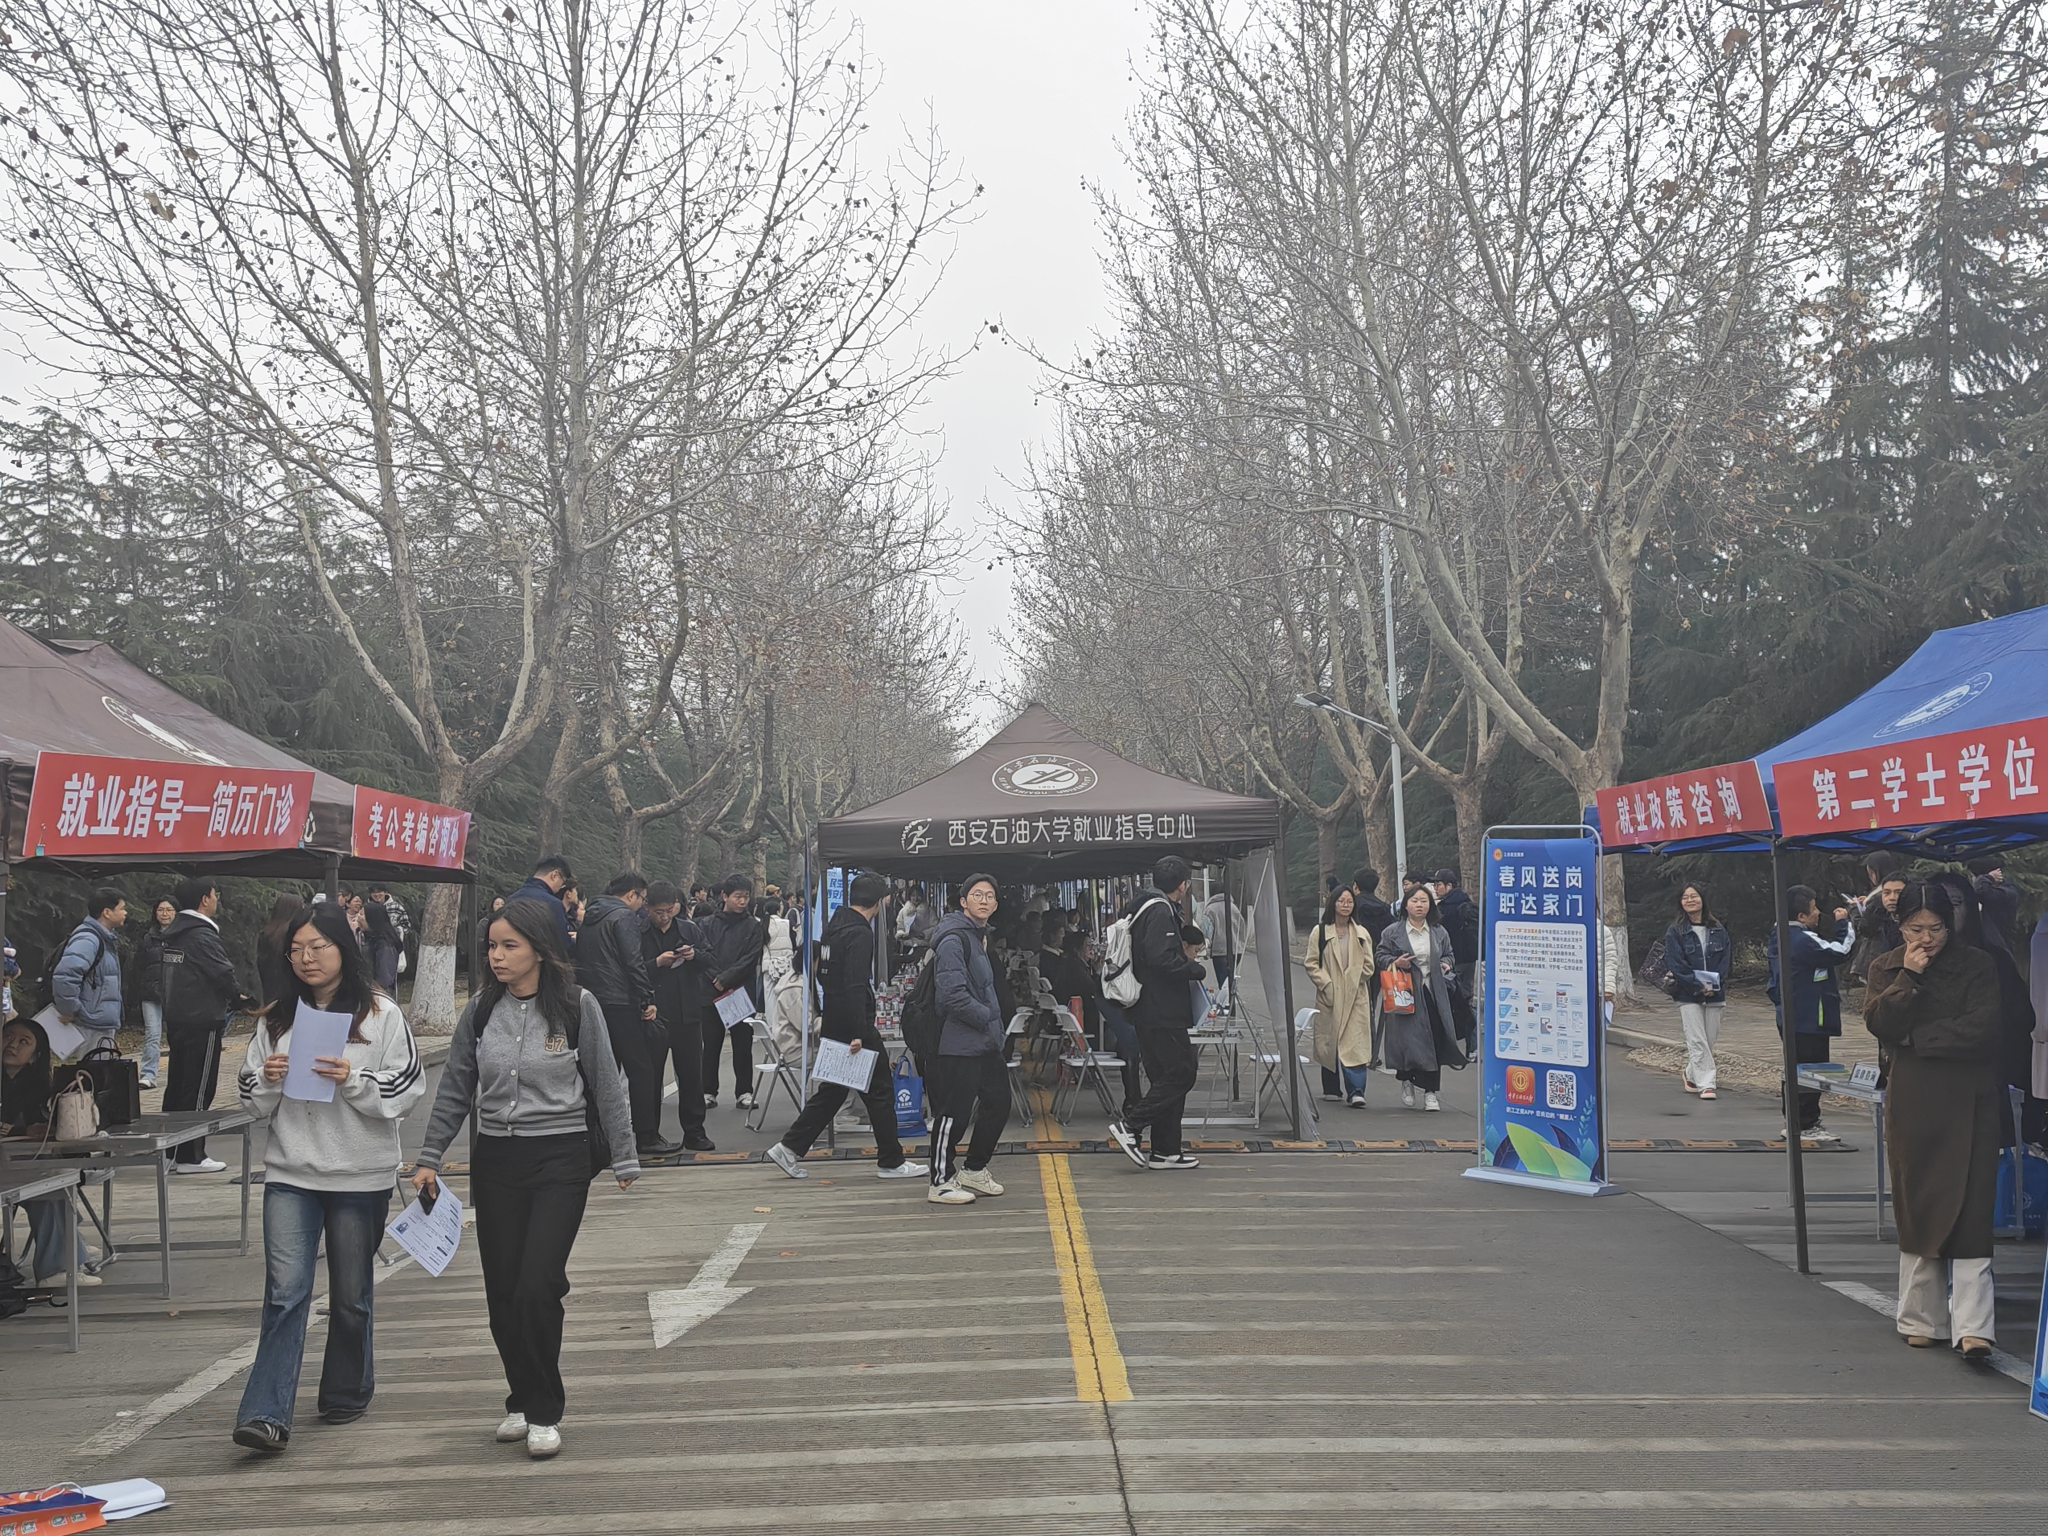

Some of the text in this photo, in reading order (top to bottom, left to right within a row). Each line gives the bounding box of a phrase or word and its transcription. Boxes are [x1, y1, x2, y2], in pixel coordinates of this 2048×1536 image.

[1812, 736, 2039, 821] 第二学士学位
[1616, 776, 1742, 835] 就业政策咨询
[368, 801, 460, 858] 考公考编咨询处
[948, 813, 1196, 847] 西安石油大学就业指导中心
[1499, 865, 1582, 889] 春风送岗
[545, 1036, 565, 1052] 97
